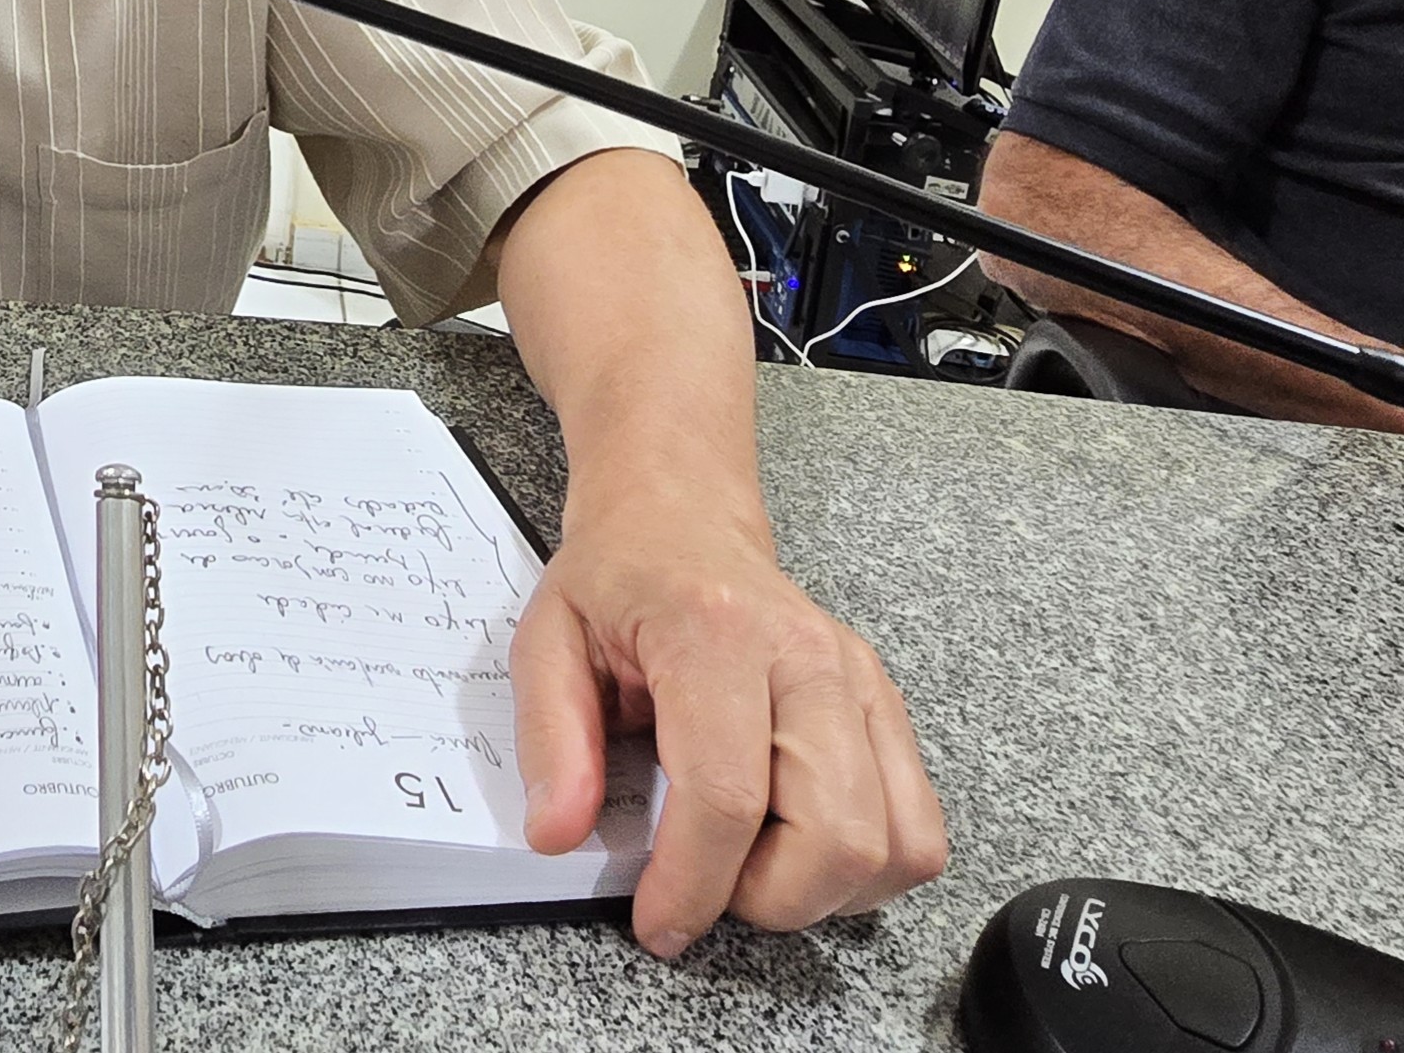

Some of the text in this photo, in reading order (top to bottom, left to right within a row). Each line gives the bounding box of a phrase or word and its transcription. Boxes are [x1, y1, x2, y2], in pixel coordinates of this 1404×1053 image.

[23, 782, 99, 799] OUTUBRO
[202, 772, 279, 799] OUTUBRO
[394, 772, 463, 813] 15
[1069, 897, 1106, 973] LYCO
